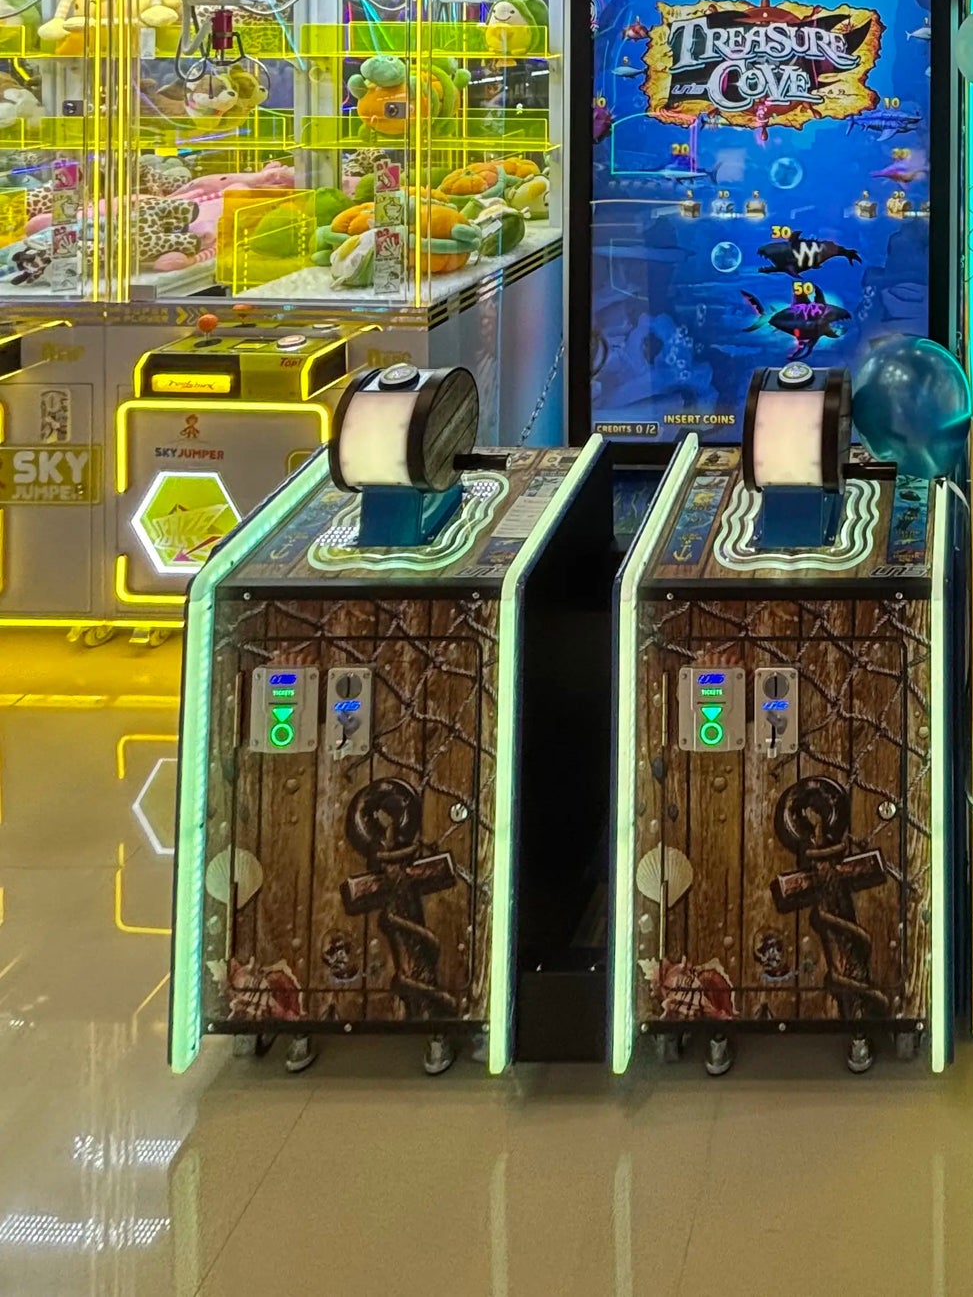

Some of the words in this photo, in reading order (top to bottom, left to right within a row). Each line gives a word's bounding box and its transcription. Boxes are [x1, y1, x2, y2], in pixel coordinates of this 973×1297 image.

[669, 12, 859, 71] TREASURE
[709, 60, 823, 110] COVE
[883, 96, 900, 109] 10
[771, 226, 792, 239] 30
[793, 282, 814, 296] 50
[664, 415, 701, 424] INSERT
[703, 415, 735, 424] COINS
[597, 425, 631, 433] CREDITS
[13, 451, 88, 484] SKY
